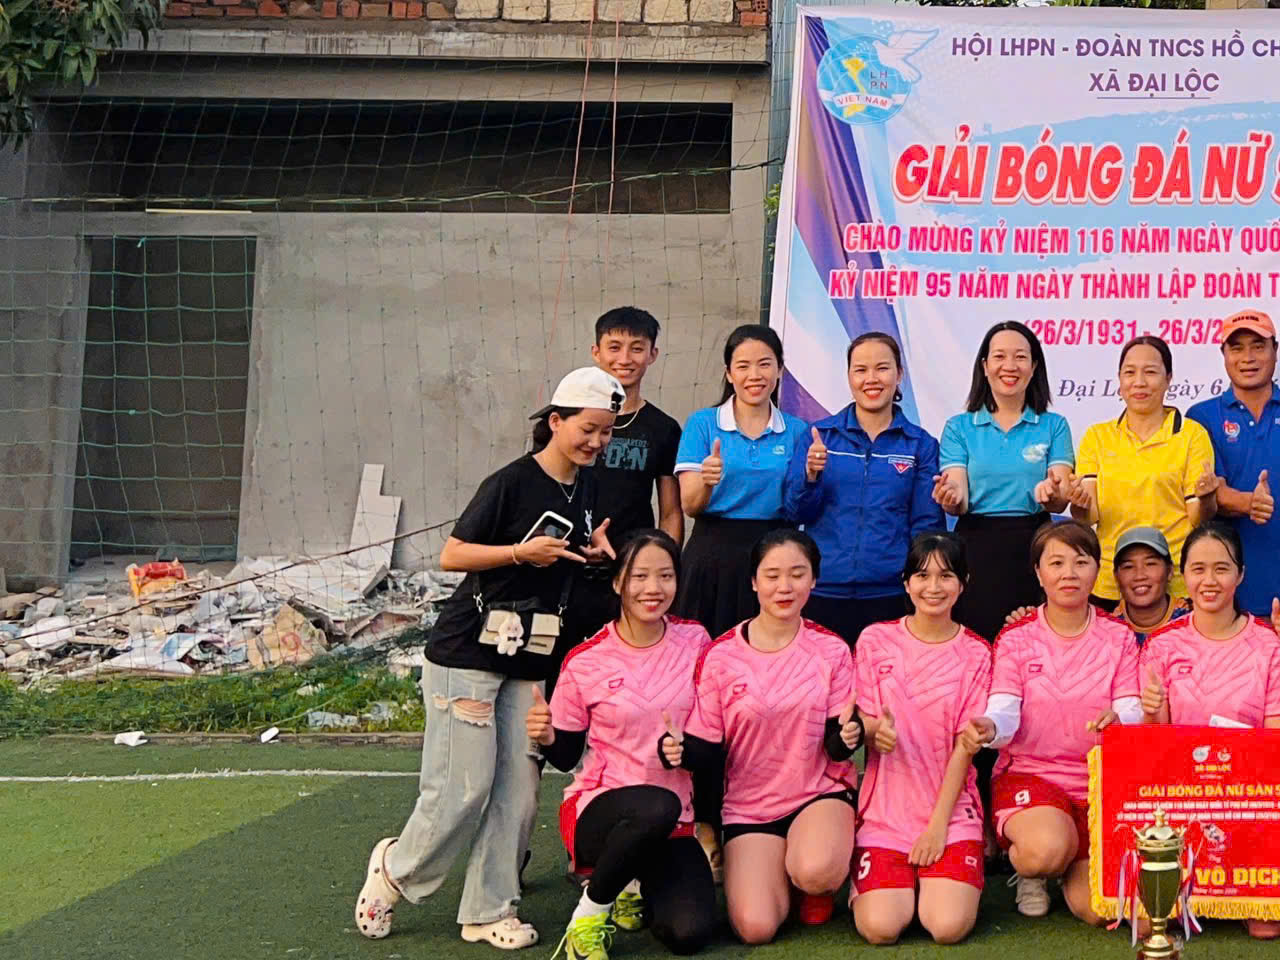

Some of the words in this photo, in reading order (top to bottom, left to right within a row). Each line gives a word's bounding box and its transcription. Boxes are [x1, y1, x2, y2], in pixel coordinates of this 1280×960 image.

[951, 32, 992, 61] HỘI
[1000, 37, 1056, 57] LHPN
[1075, 33, 1142, 58] ĐOÀN
[1149, 38, 1205, 58] TNCS
[1211, 29, 1245, 58] HỒ
[1088, 68, 1121, 92] XÃ
[1128, 72, 1165, 97] ĐẠI
[1174, 68, 1220, 97] LỘC
[865, 95, 888, 107] NAM
[893, 123, 990, 202] GIẢI
[994, 128, 1124, 202] BÓNG
[1129, 128, 1193, 201] ĐÁ
[1200, 131, 1274, 202] NỮ
[844, 220, 901, 253] CHÀO
[908, 222, 973, 253] MỪNG
[979, 220, 1008, 254] KỶ
[1013, 223, 1070, 259] NIỆM
[1076, 228, 1114, 254] 116
[1120, 223, 1170, 254] NĂM
[1177, 223, 1234, 253] NGÀY
[829, 262, 859, 299] KỶ
[862, 265, 919, 302] NIỆM
[925, 272, 952, 297] 95
[958, 268, 1009, 299] NĂM
[1016, 267, 1073, 299] NGÀY
[1081, 268, 1150, 299] THÀNH
[1157, 267, 1197, 304] LẬP
[1203, 267, 1262, 299] ĐOÀN
[1158, 319, 1224, 345] 26/3/2
[1057, 378, 1096, 401] Đại
[1166, 379, 1205, 400] gày
[1210, 378, 1223, 396] 6
[1194, 865, 1226, 886] VÔ
